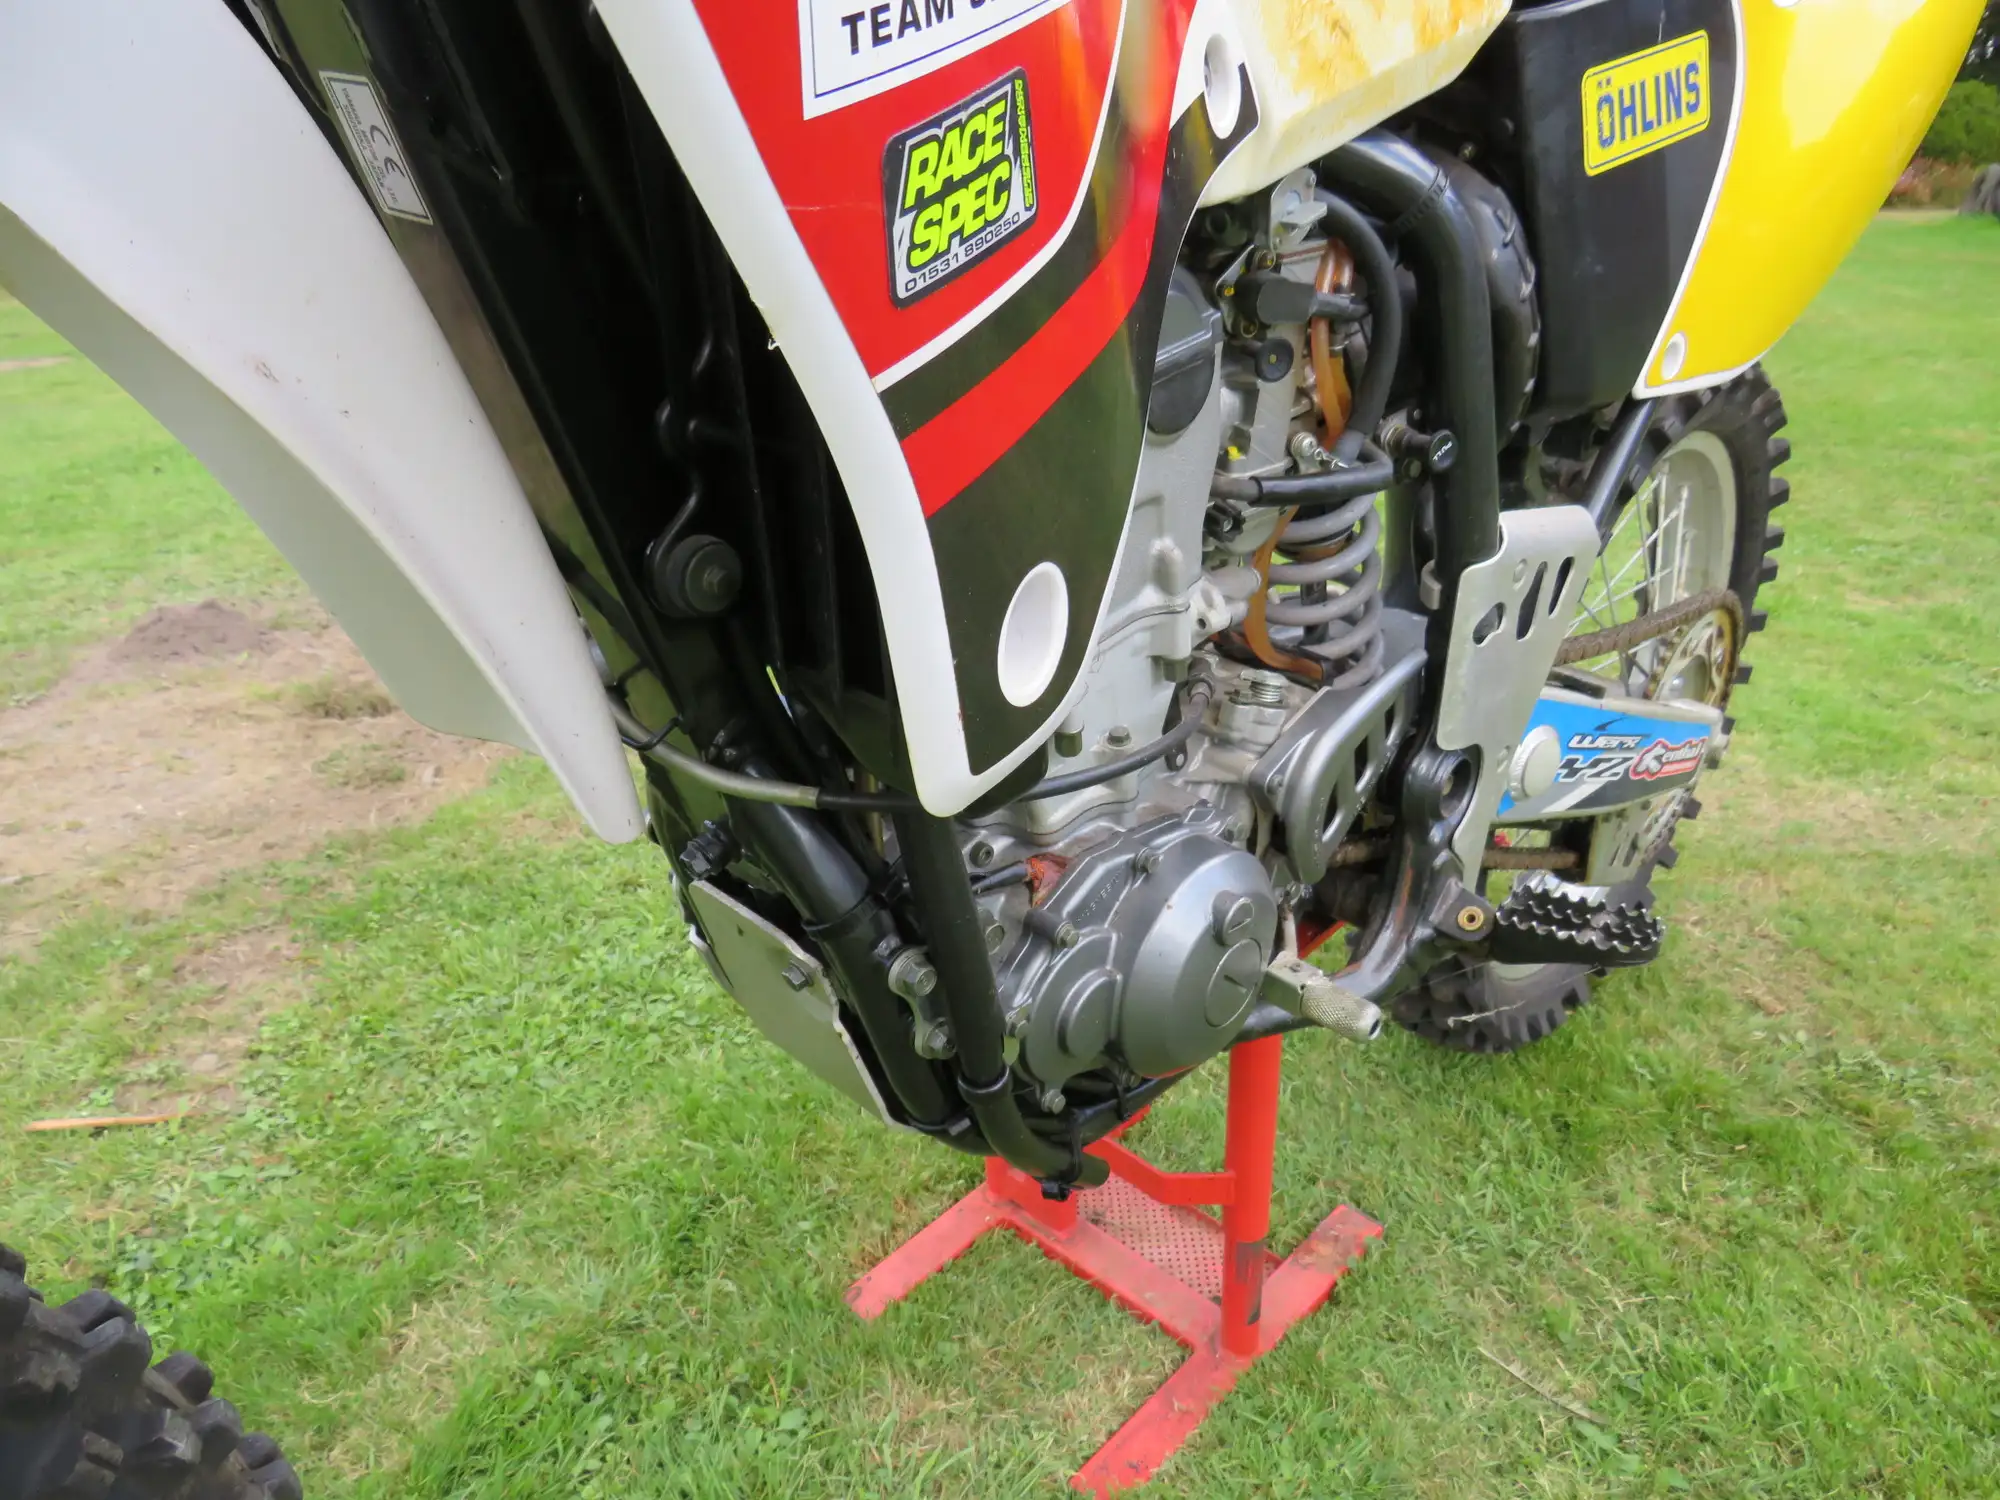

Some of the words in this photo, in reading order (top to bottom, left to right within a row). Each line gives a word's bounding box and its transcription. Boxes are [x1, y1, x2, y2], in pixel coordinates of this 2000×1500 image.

[841, 0, 954, 56] TEAM
[1596, 61, 1701, 149] ÖHLINS
[903, 98, 1007, 209] RACE
[904, 250, 960, 293] 01531
[963, 211, 1022, 259] 890250
[908, 160, 1011, 268] SPEC
[1556, 755, 1636, 781] YZ
